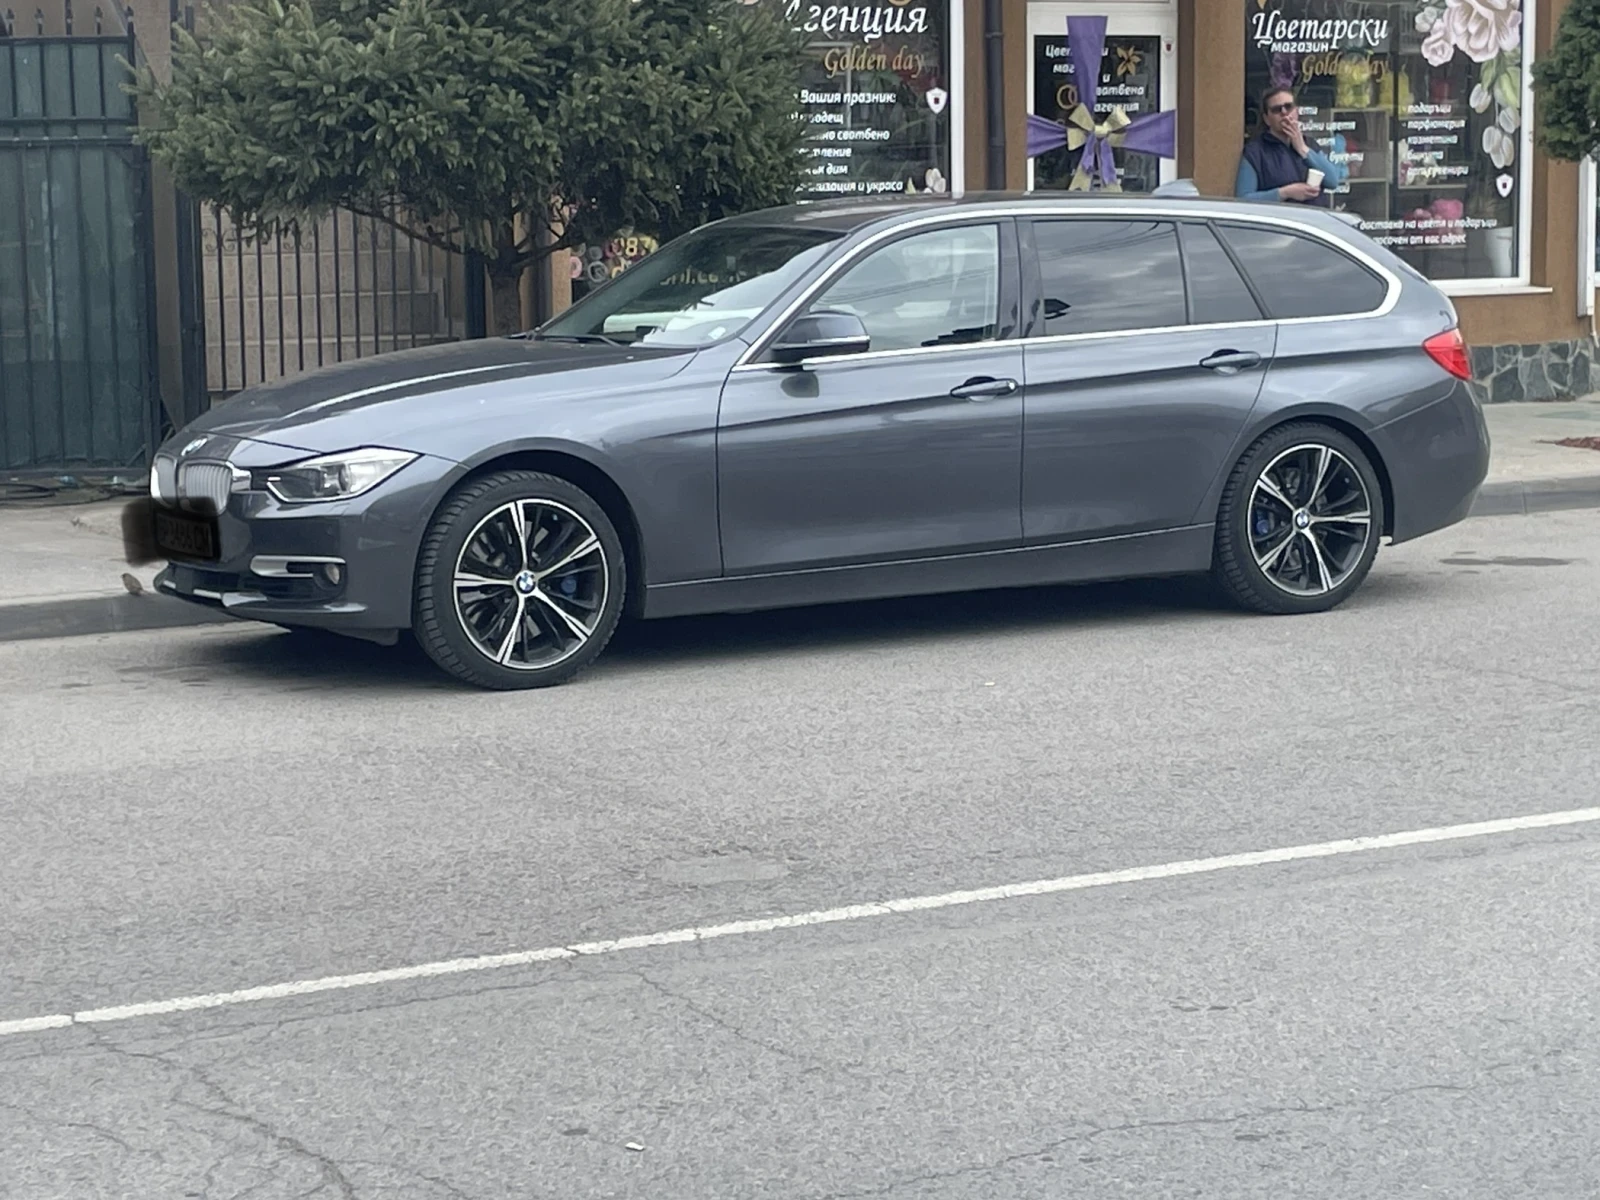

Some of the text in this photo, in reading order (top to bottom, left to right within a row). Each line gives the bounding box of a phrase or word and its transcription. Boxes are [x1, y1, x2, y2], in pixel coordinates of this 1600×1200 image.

[1252, 10, 1388, 50] Цветарски
[1270, 41, 1330, 53] магазин
[824, 45, 924, 79] Golden day
[800, 89, 897, 107] Вашия празник:
[836, 127, 890, 141] сватбено
[826, 162, 848, 175] дим
[866, 181, 904, 194] украса
